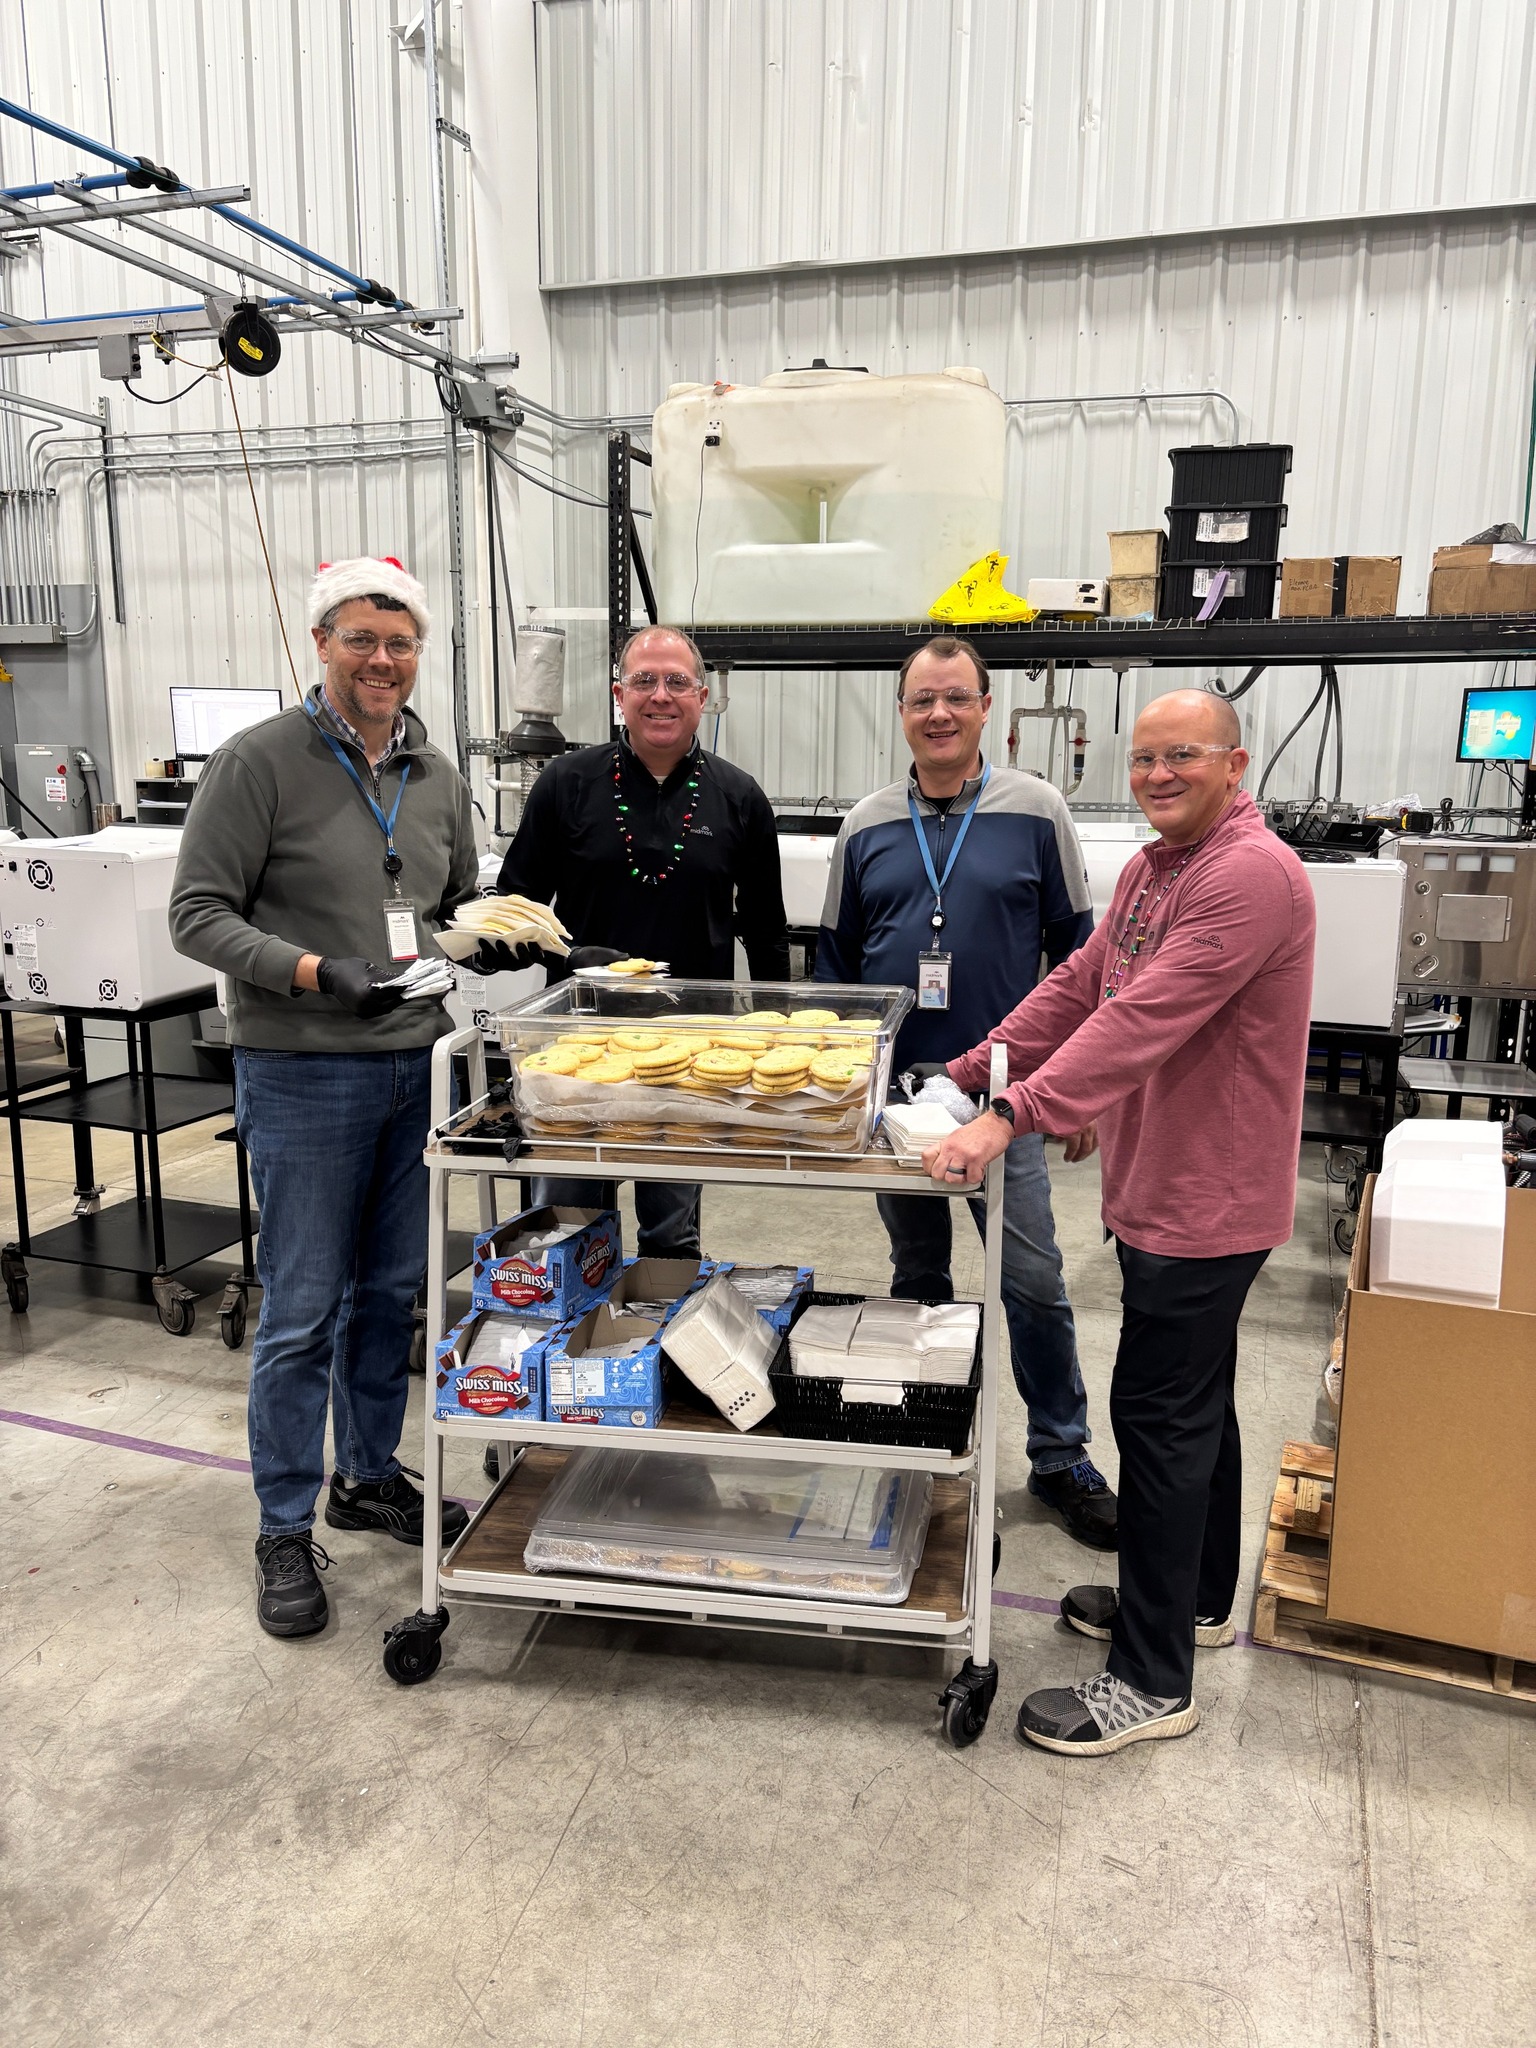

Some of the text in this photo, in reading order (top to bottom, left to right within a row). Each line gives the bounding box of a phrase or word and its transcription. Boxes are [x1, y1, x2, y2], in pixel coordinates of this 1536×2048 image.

[1191, 936, 1225, 950] midmark
[500, 1288, 512, 1296] Milk
[476, 1299, 484, 1308] 50
[480, 1396, 508, 1404] Chocolate
[440, 1409, 449, 1418] 50
